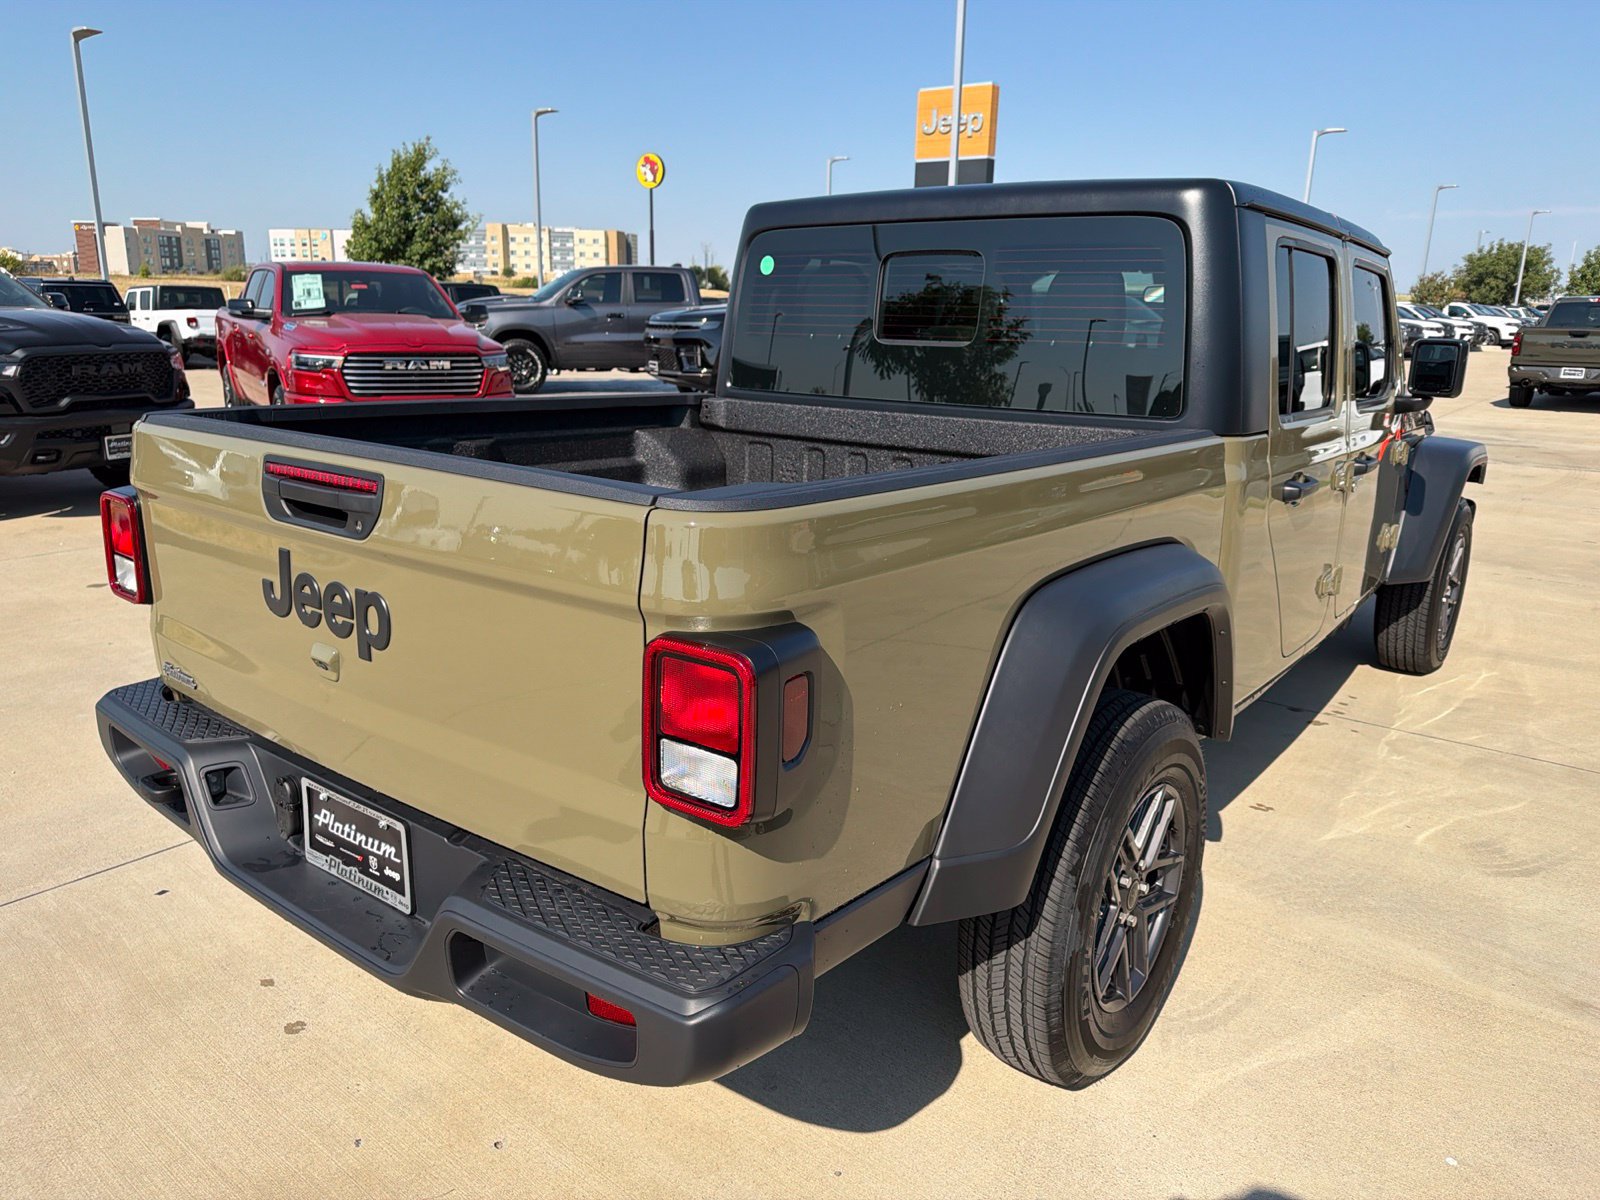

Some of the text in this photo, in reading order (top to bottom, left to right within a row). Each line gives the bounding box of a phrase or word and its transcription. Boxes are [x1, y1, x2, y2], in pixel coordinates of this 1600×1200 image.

[72, 362, 143, 377] RAM
[383, 360, 451, 370] RAM
[262, 547, 391, 662] Jeep
[314, 809, 401, 862] Platinum
[328, 858, 388, 901] Platinum
[384, 866, 401, 881] Jeep
